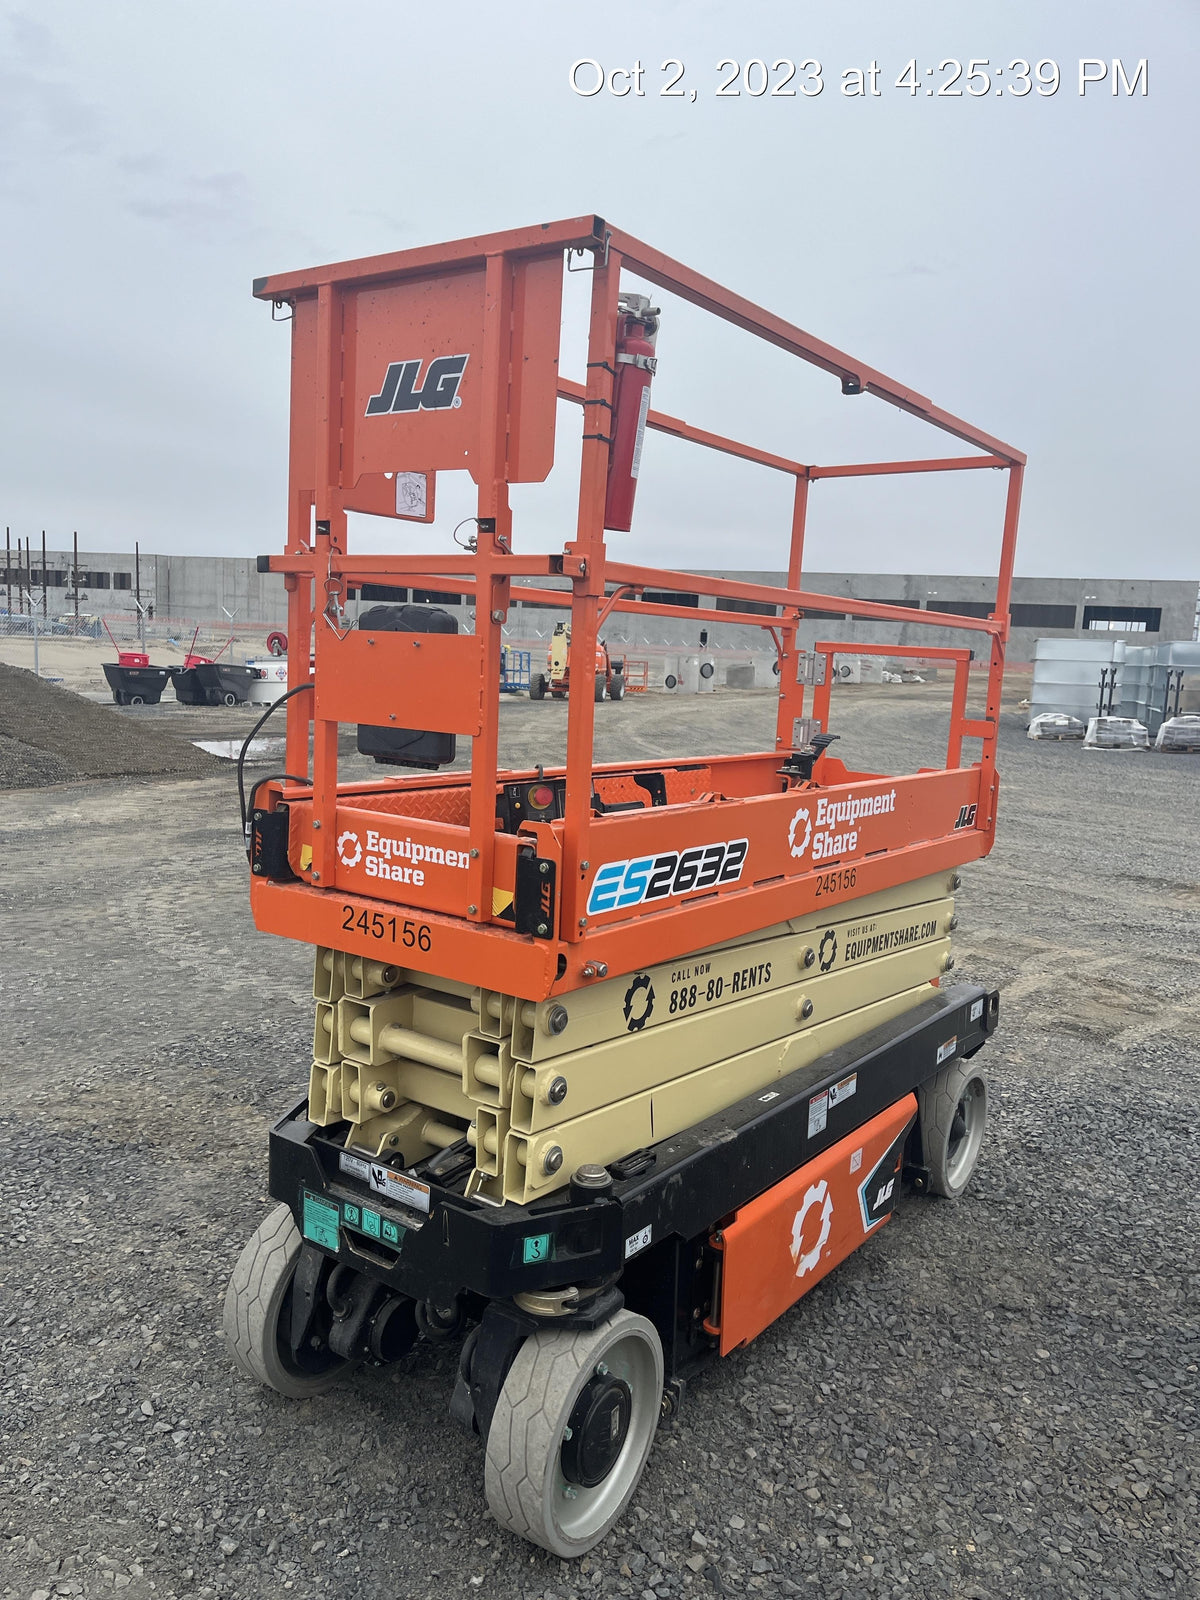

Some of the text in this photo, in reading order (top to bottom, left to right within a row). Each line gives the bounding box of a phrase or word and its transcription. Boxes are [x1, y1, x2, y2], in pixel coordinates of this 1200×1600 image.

[365, 353, 470, 417] JLG
[815, 789, 897, 830] Equipment
[954, 803, 978, 831] JLG
[366, 830, 470, 869] Equipmen
[811, 830, 858, 861] Share
[365, 855, 425, 886] Share
[587, 838, 749, 916] ES2632
[815, 868, 857, 897] 245156
[540, 880, 551, 918] JLG
[342, 905, 432, 952] 245156
[845, 920, 937, 961] EQUIPMENTSHARE.COM
[847, 927, 861, 938] VISIT
[862, 925, 868, 934] US
[669, 962, 772, 1014] 888-80-RENTS
[671, 962, 711, 983] CALL NOW
[872, 1178, 895, 1211] JLG
